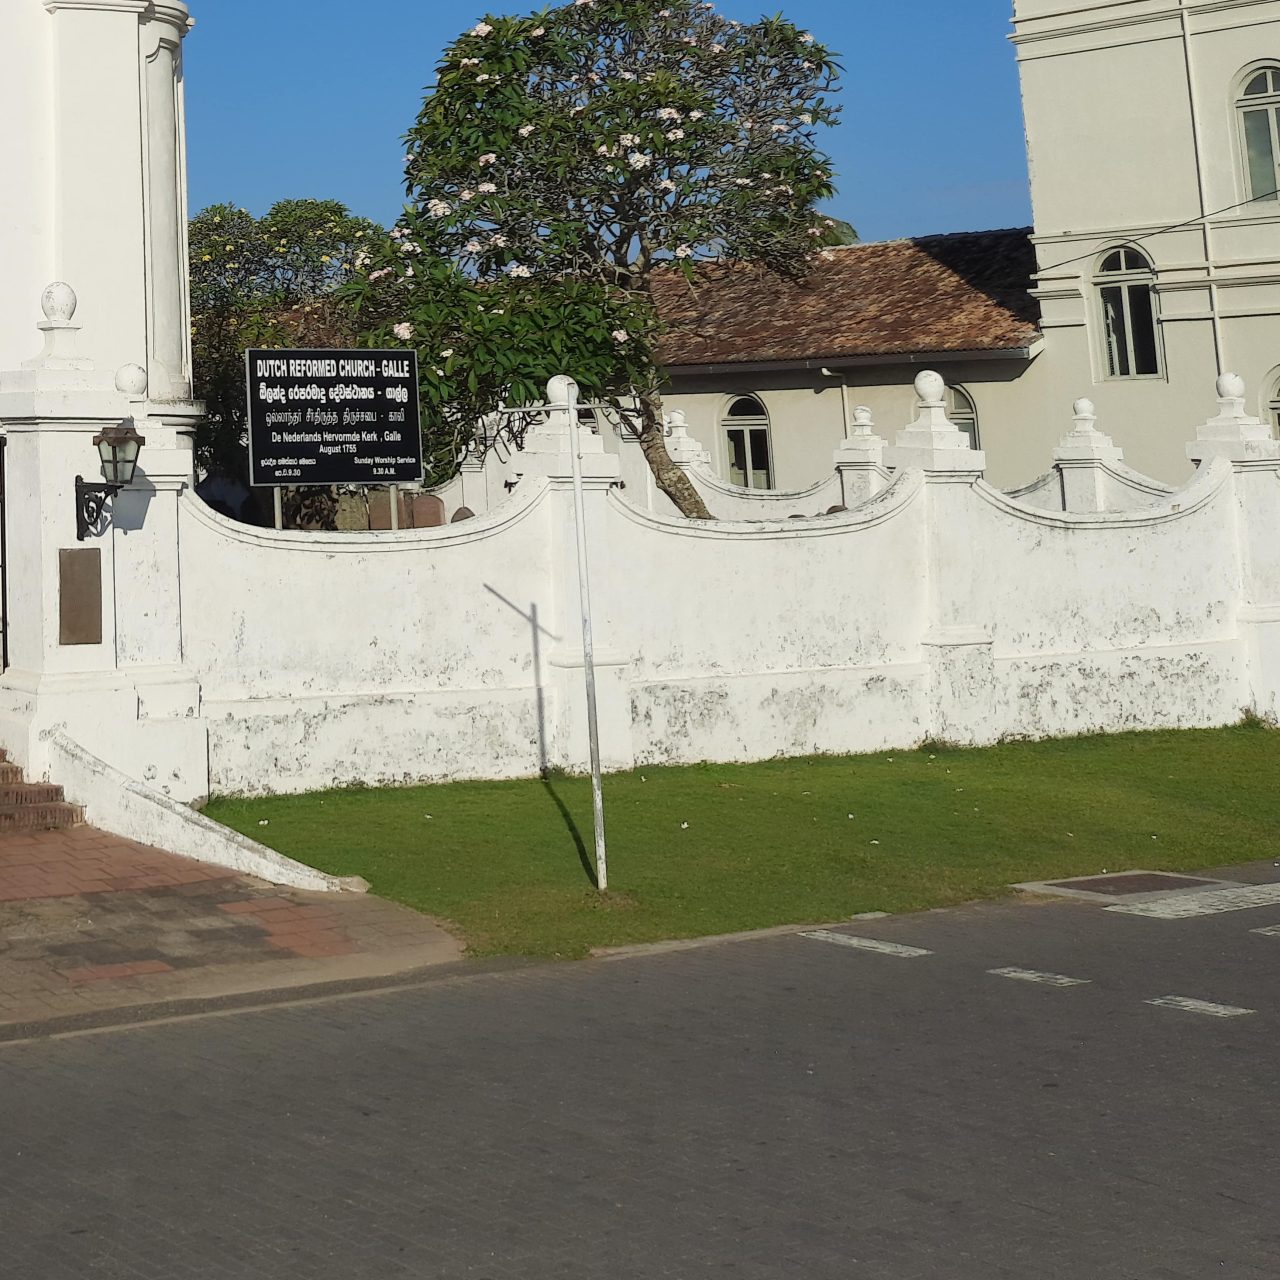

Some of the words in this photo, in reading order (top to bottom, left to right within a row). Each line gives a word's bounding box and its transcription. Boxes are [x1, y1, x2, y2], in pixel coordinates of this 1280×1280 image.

[257, 360, 287, 377] DUTCH
[289, 360, 336, 377] REFORMED
[339, 360, 375, 377] CHURCH
[382, 360, 410, 377] GALLE
[386, 384, 408, 402] ගාල්ල
[343, 408, 377, 425] திருச்சபை
[389, 408, 405, 421] காலி
[272, 432, 281, 442] De
[283, 432, 321, 442] Nederlands
[323, 431, 360, 442] Hervormde
[362, 431, 378, 441] Kerk
[384, 431, 401, 441] Galle
[319, 444, 341, 455] August
[342, 444, 357, 453] 1755
[354, 457, 373, 465] Sunday
[375, 456, 396, 464] Worship
